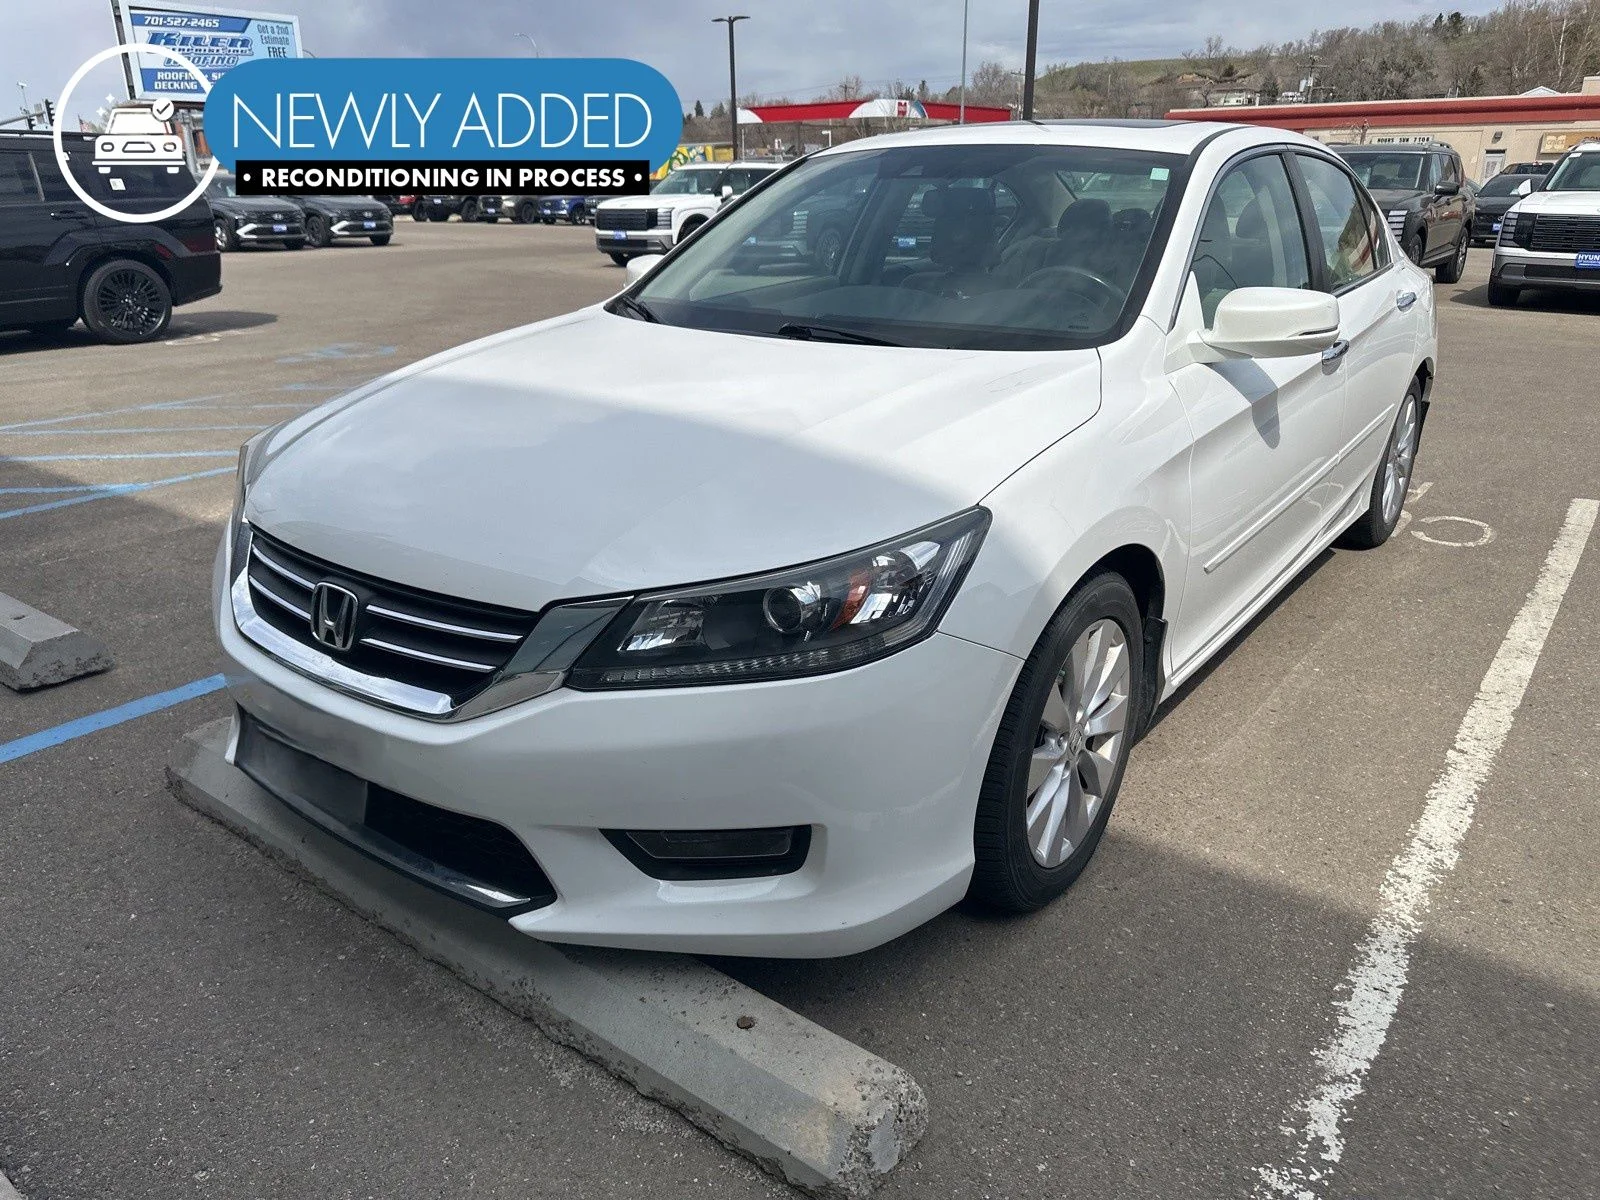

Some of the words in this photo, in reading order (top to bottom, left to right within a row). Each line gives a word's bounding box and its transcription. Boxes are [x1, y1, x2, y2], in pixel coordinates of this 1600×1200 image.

[144, 16, 219, 28] 701-527-2465
[257, 24, 269, 34] Get
[270, 26, 275, 34] a
[276, 25, 290, 35] 2nd
[260, 35, 290, 45] Estimate
[268, 46, 287, 58] FREE
[157, 71, 196, 80] ROOFIN
[154, 81, 198, 90] DECKING
